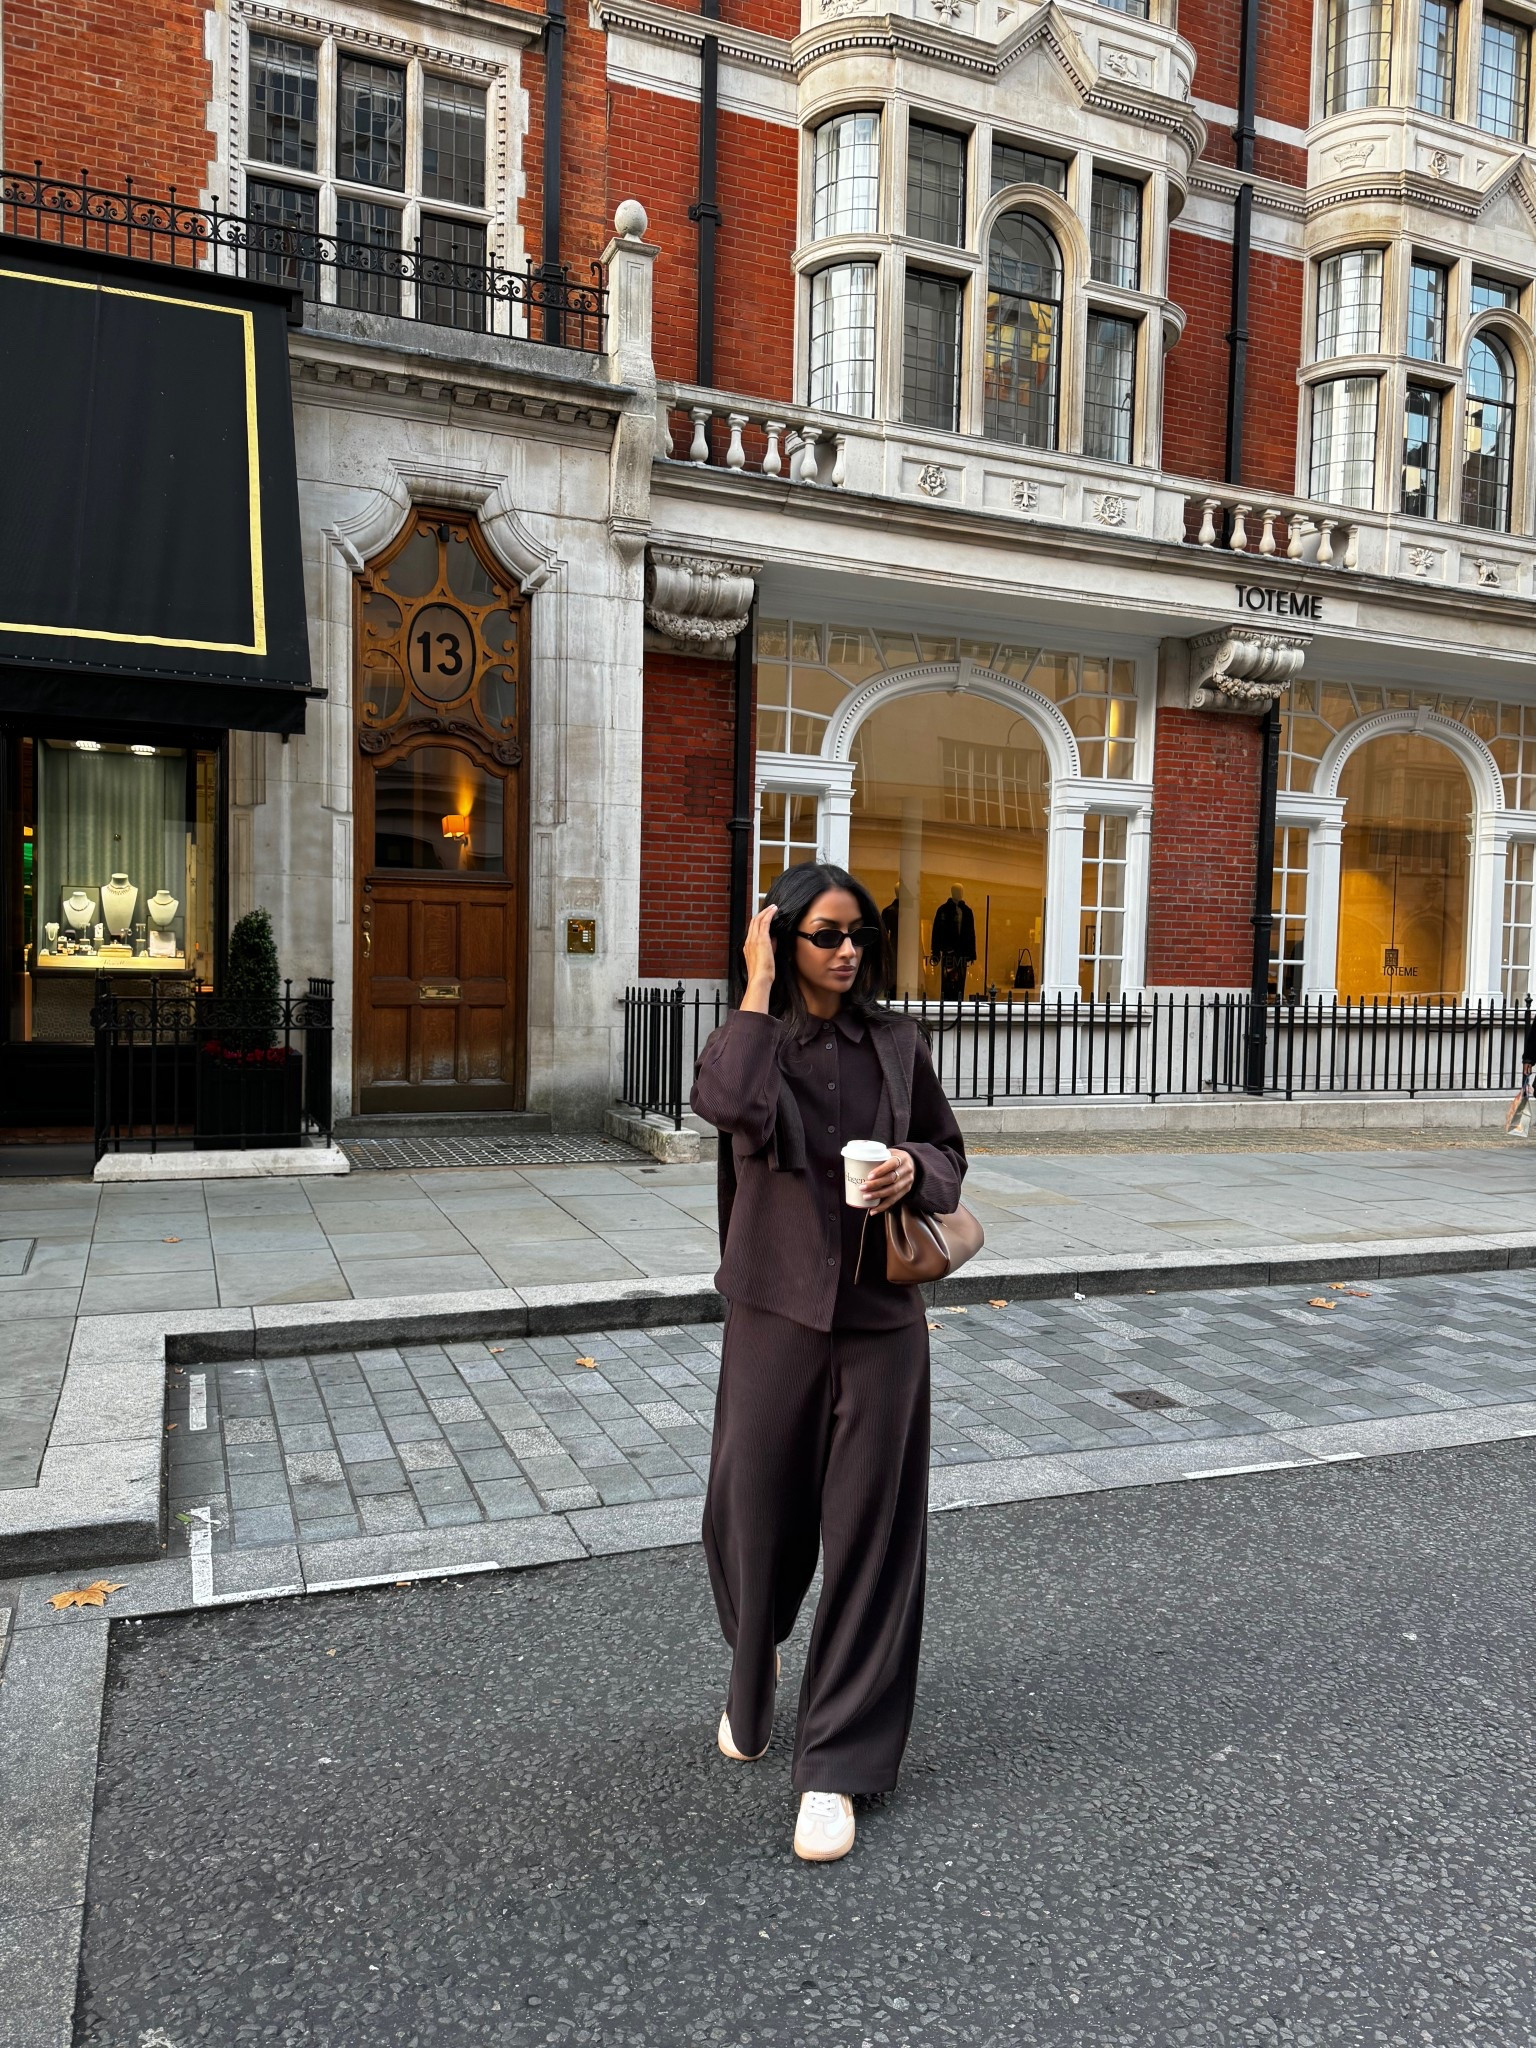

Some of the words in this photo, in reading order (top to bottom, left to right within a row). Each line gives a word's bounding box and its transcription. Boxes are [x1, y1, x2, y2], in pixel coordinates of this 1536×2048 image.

[1235, 584, 1323, 619] TOTEME
[416, 630, 463, 676] 13
[1382, 966, 1418, 977] TOTEME
